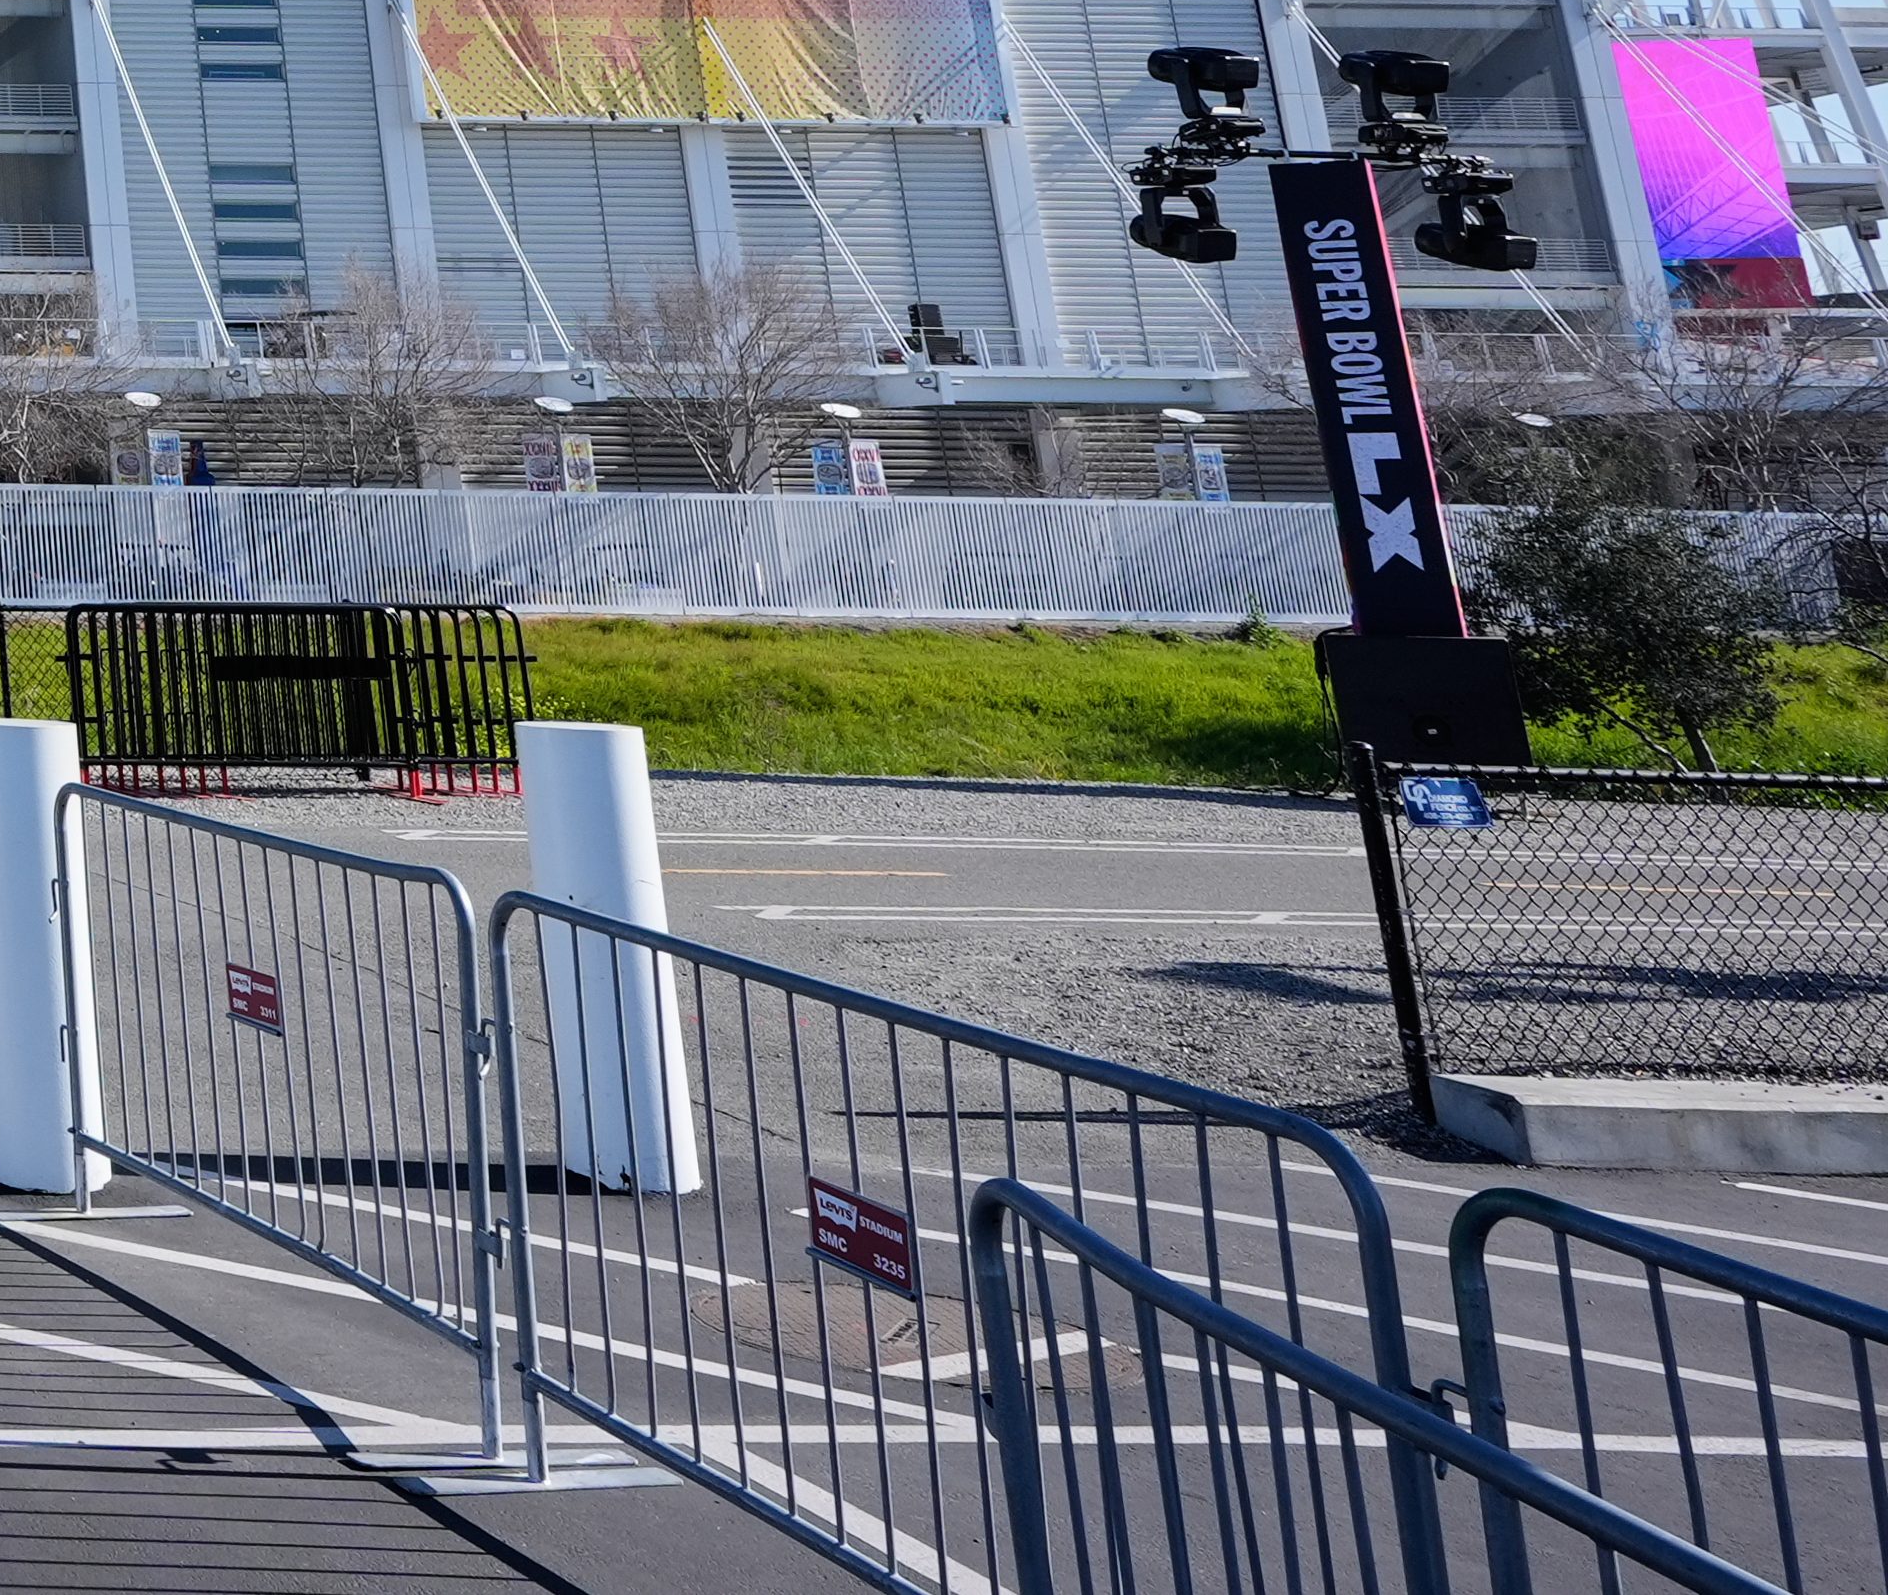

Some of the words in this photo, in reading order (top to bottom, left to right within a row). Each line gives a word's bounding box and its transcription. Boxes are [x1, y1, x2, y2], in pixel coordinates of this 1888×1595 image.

[1303, 218, 1372, 322] SUPER
[1326, 331, 1393, 425] BOWL
[1346, 432, 1425, 573] LX
[259, 1005, 277, 1021] 3311
[818, 1227, 848, 1253] SMC
[872, 1253, 906, 1280] 3235
[859, 1215, 904, 1245] STADIUM
